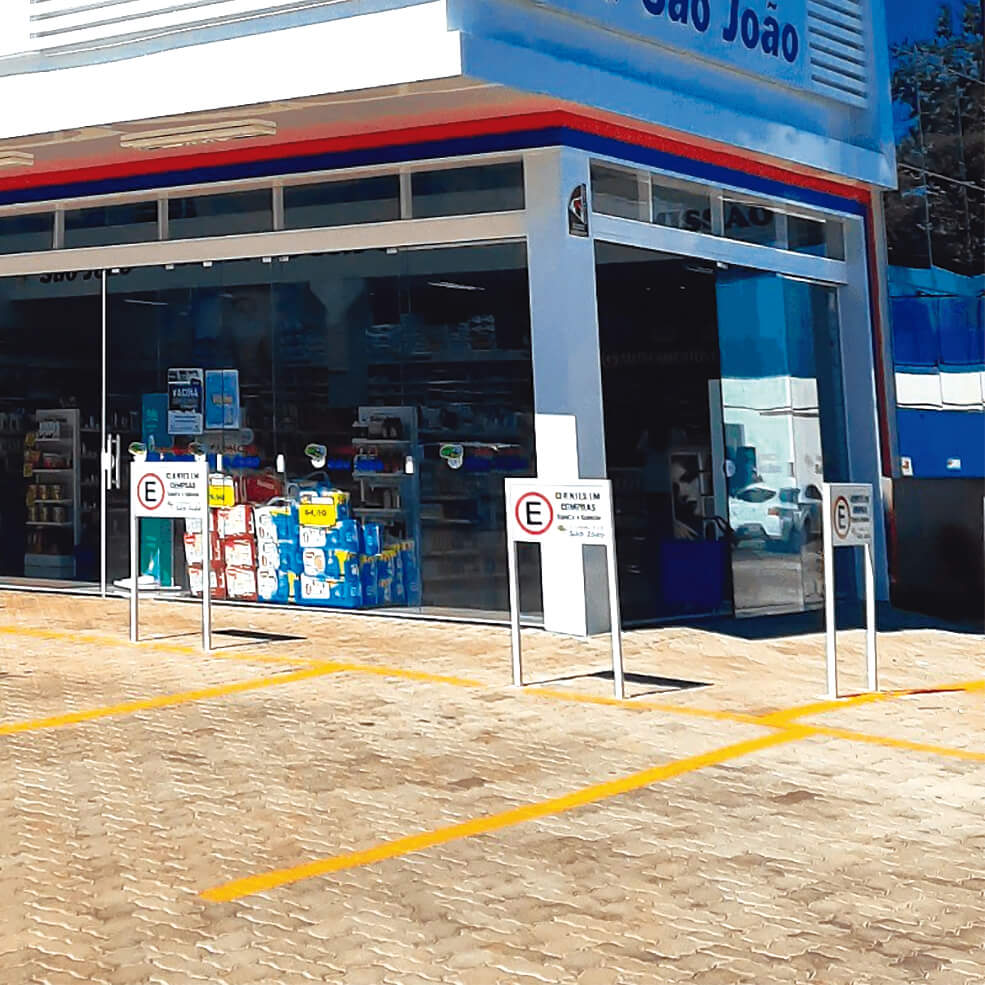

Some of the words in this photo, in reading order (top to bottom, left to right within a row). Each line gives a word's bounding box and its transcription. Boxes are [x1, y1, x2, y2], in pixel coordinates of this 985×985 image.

[144, 481, 157, 502] E
[525, 501, 543, 526] E
[838, 504, 847, 529] E
